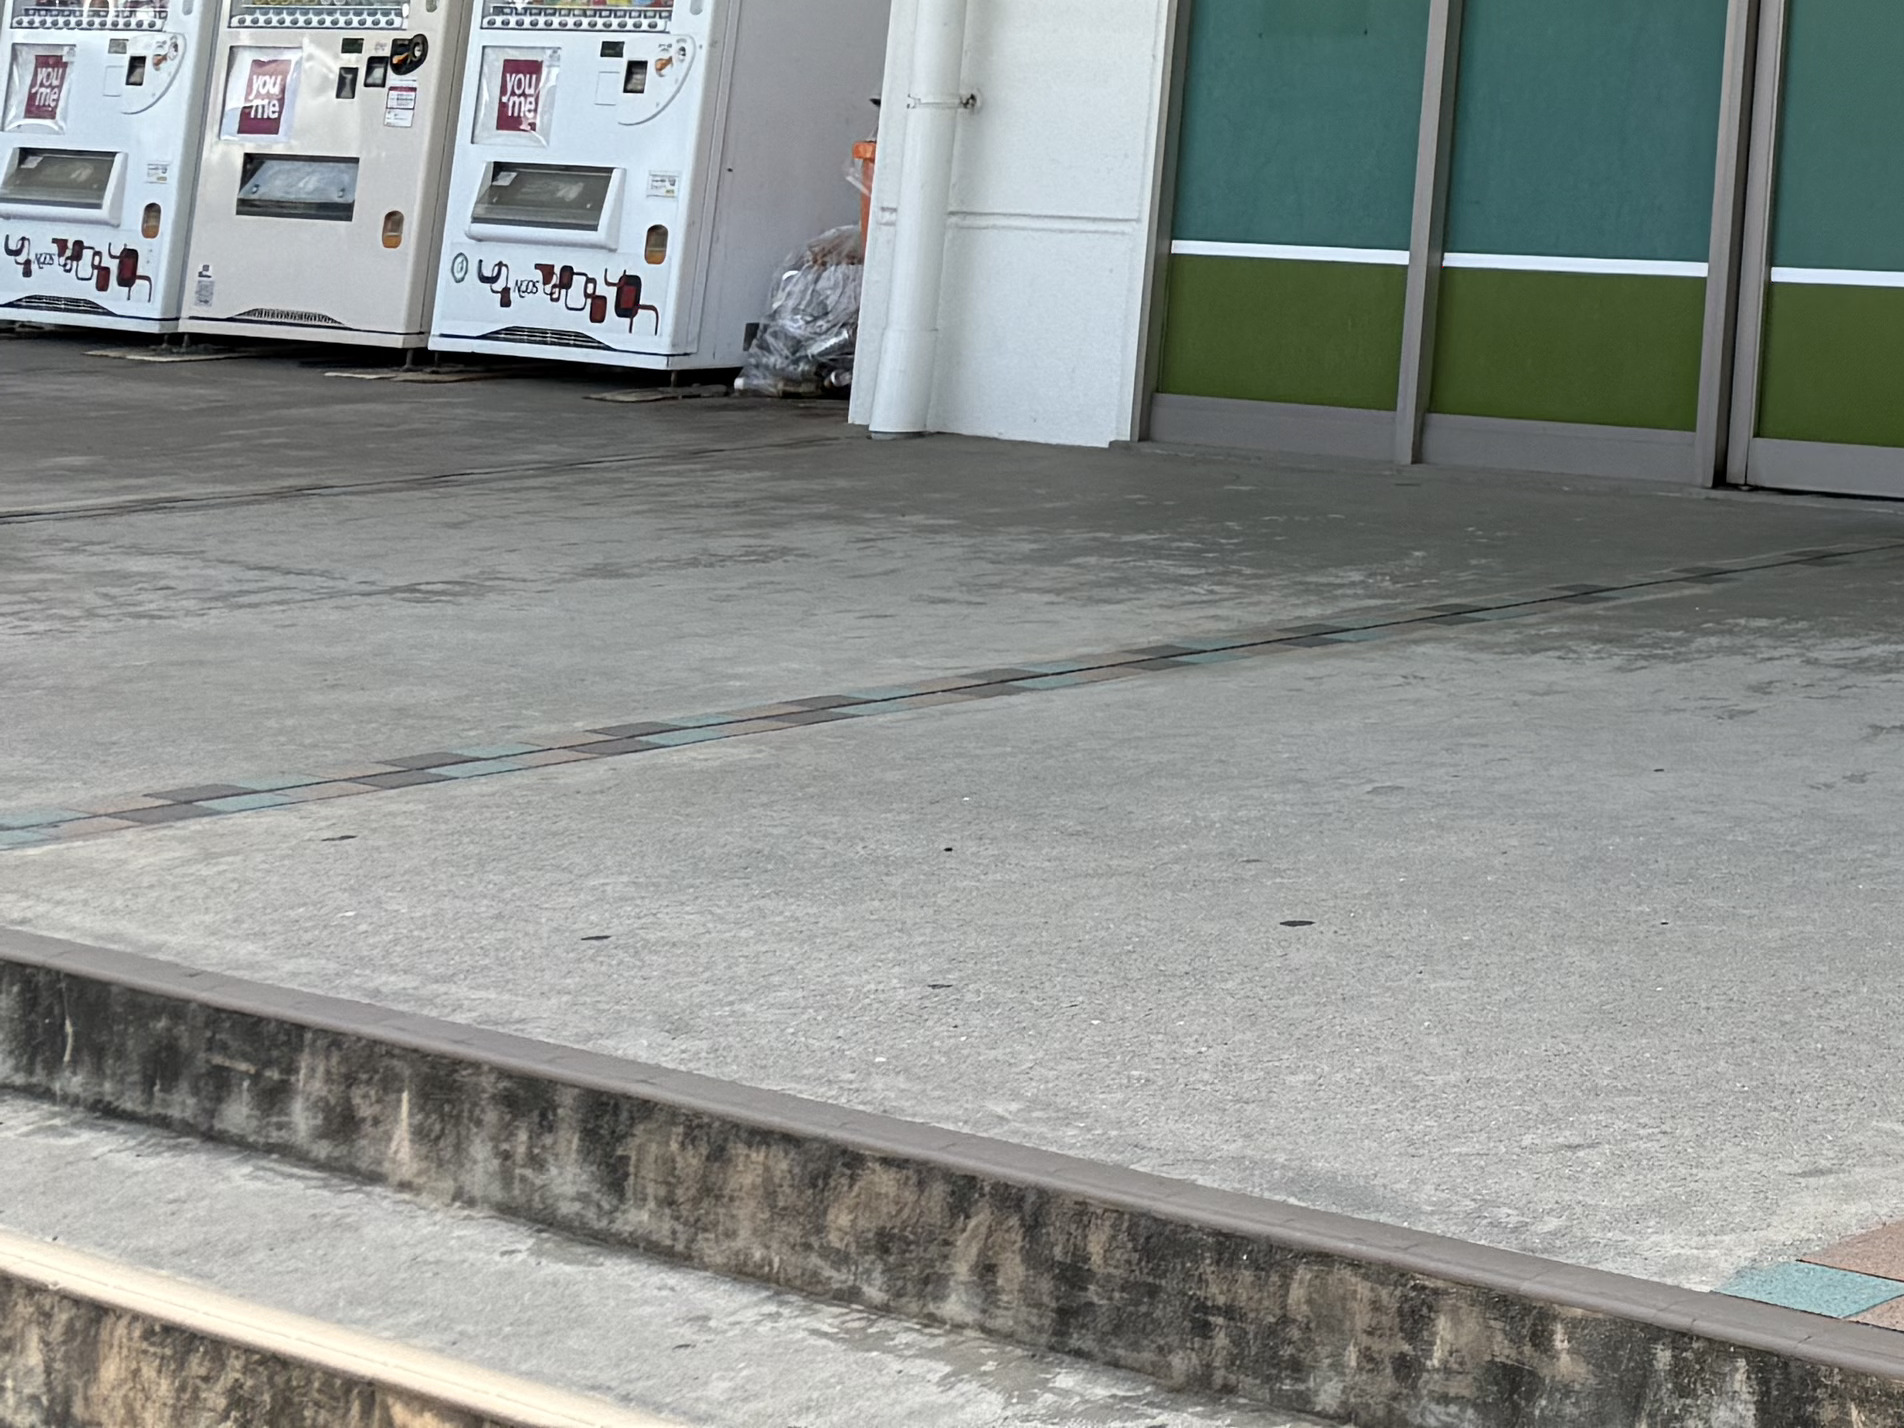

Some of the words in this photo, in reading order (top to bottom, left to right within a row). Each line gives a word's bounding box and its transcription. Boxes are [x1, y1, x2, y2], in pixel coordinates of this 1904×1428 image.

[33, 66, 63, 92] you
[249, 73, 281, 100] you
[502, 72, 537, 103] you
[35, 87, 58, 107] me
[249, 98, 280, 120] me
[508, 95, 536, 118] me
